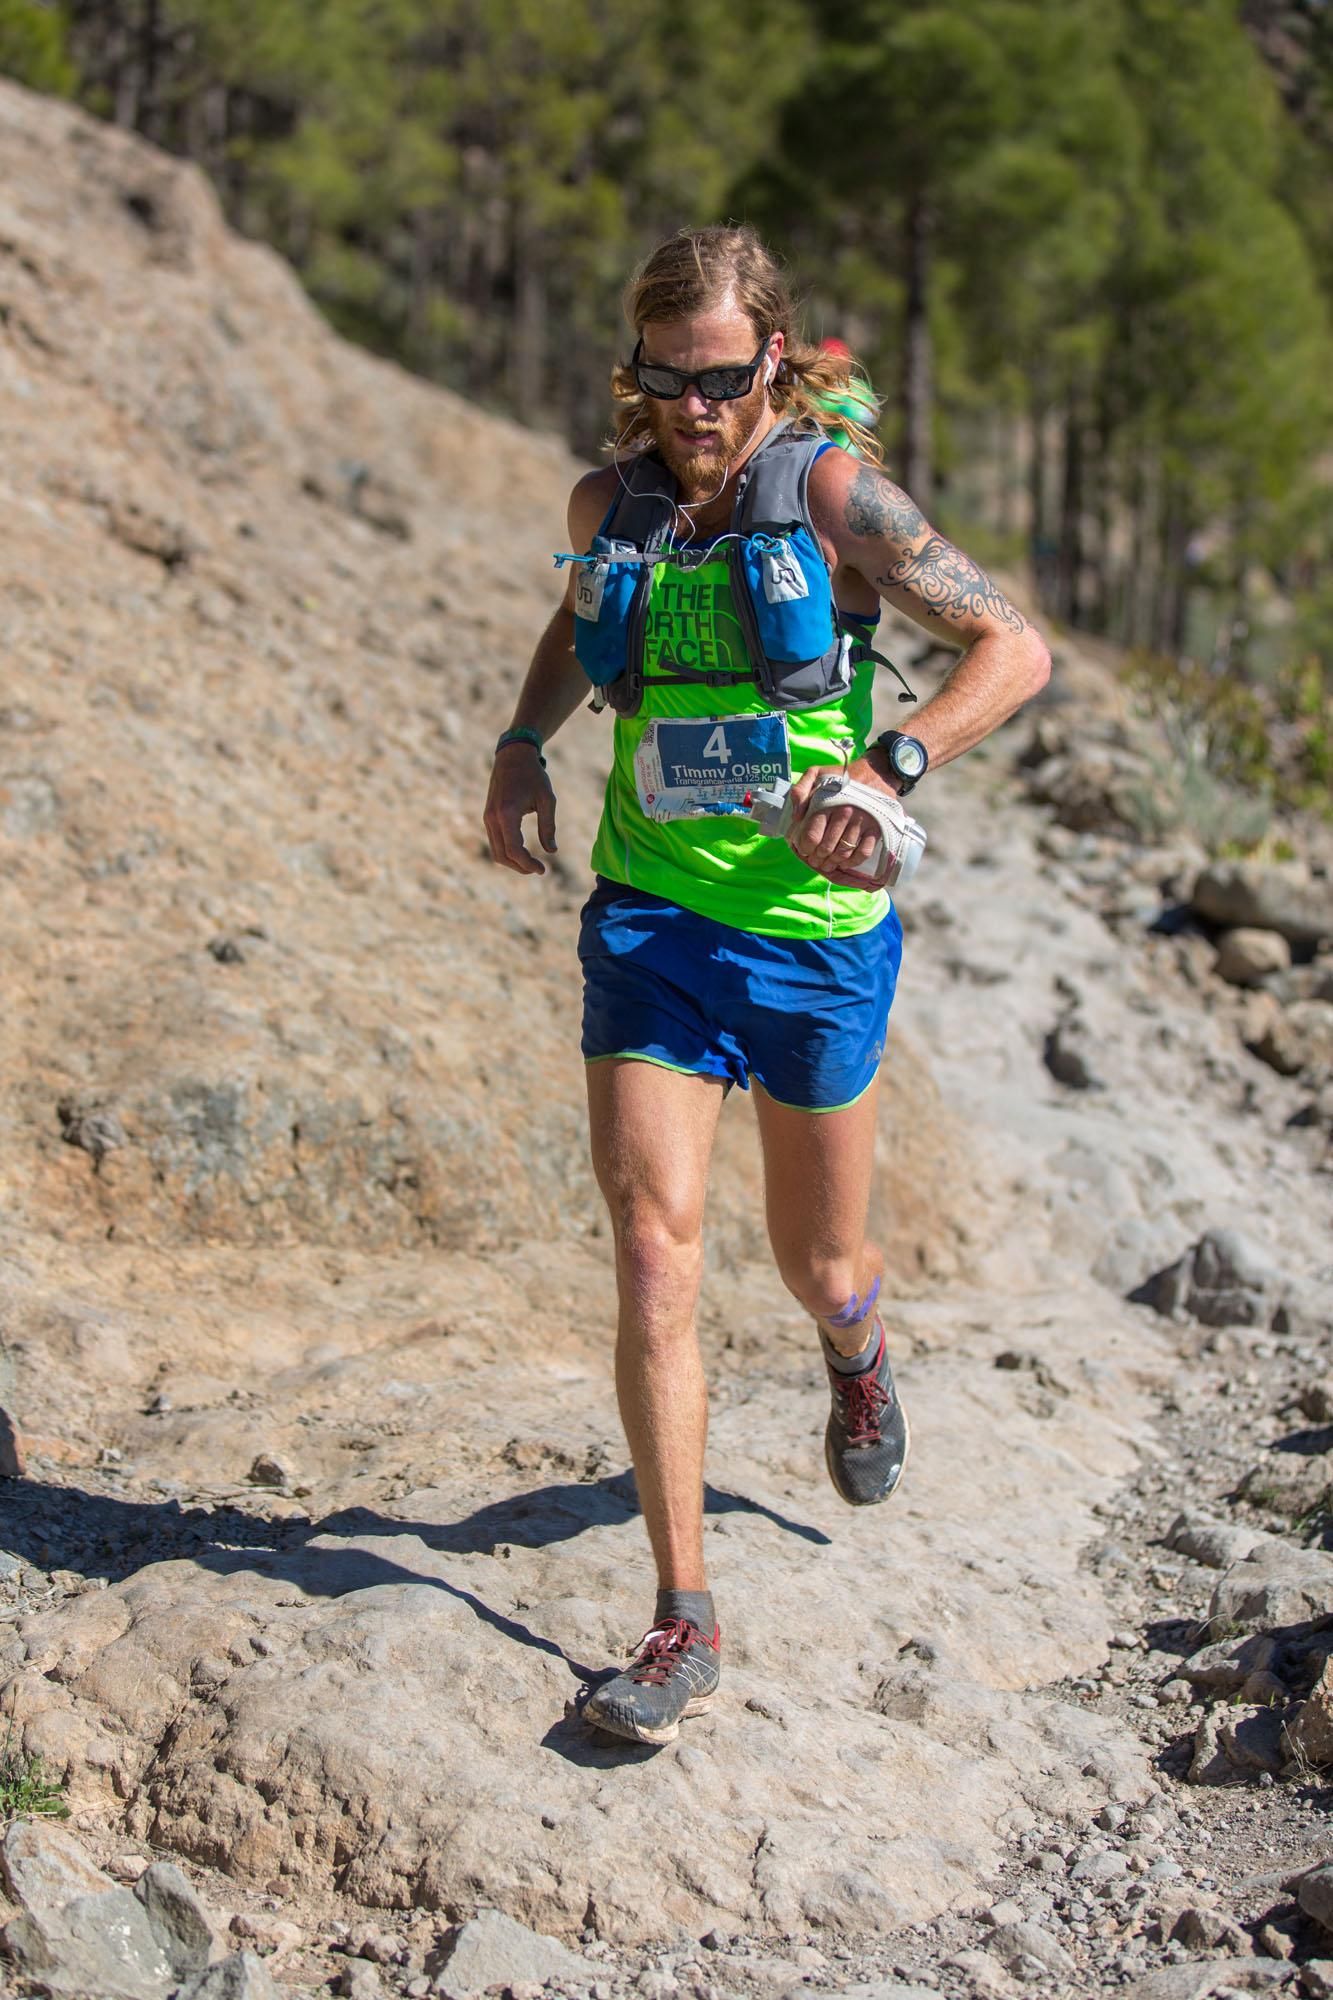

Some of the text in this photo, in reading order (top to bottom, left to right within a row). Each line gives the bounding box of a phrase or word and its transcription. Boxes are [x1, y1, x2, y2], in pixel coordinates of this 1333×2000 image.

[660, 583, 712, 611] THE
[644, 639, 717, 668] FACE
[702, 725, 733, 764] 4
[731, 762, 783, 777] Olson
[745, 774, 760, 783] 125
[761, 772, 778, 783] Km
